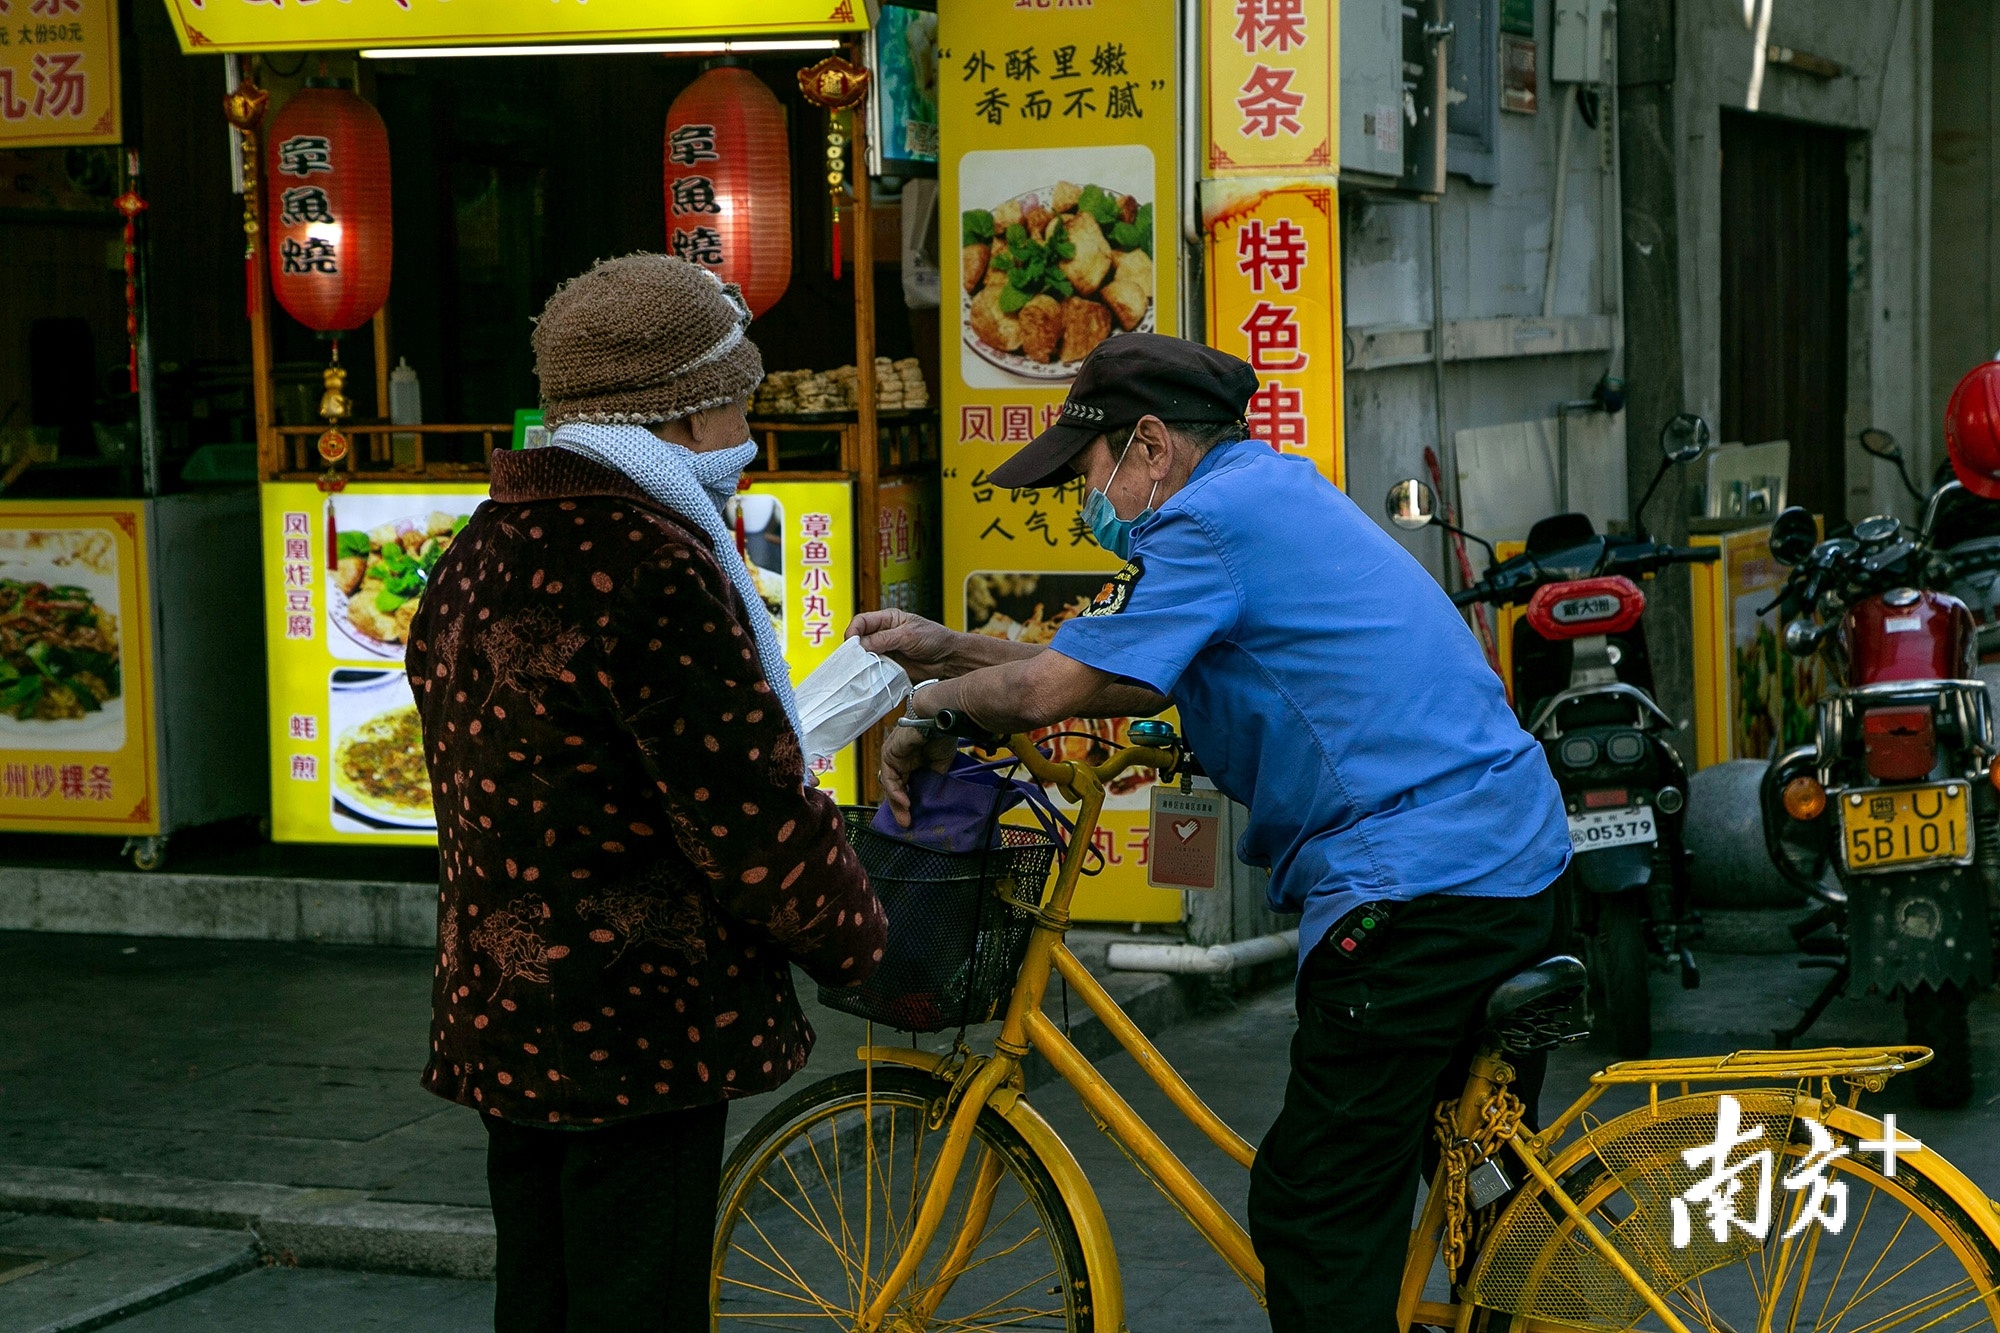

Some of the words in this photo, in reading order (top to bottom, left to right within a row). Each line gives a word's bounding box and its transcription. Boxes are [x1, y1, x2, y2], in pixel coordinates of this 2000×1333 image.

[18, 23, 82, 44] 大份50元
[283, 512, 314, 638] 凤凰炸豆腐
[801, 514, 832, 645] 章鱼小丸子
[288, 716, 317, 780] 蚝煎
[1586, 820, 1652, 842] 05379
[1852, 820, 1956, 862] 5B101
